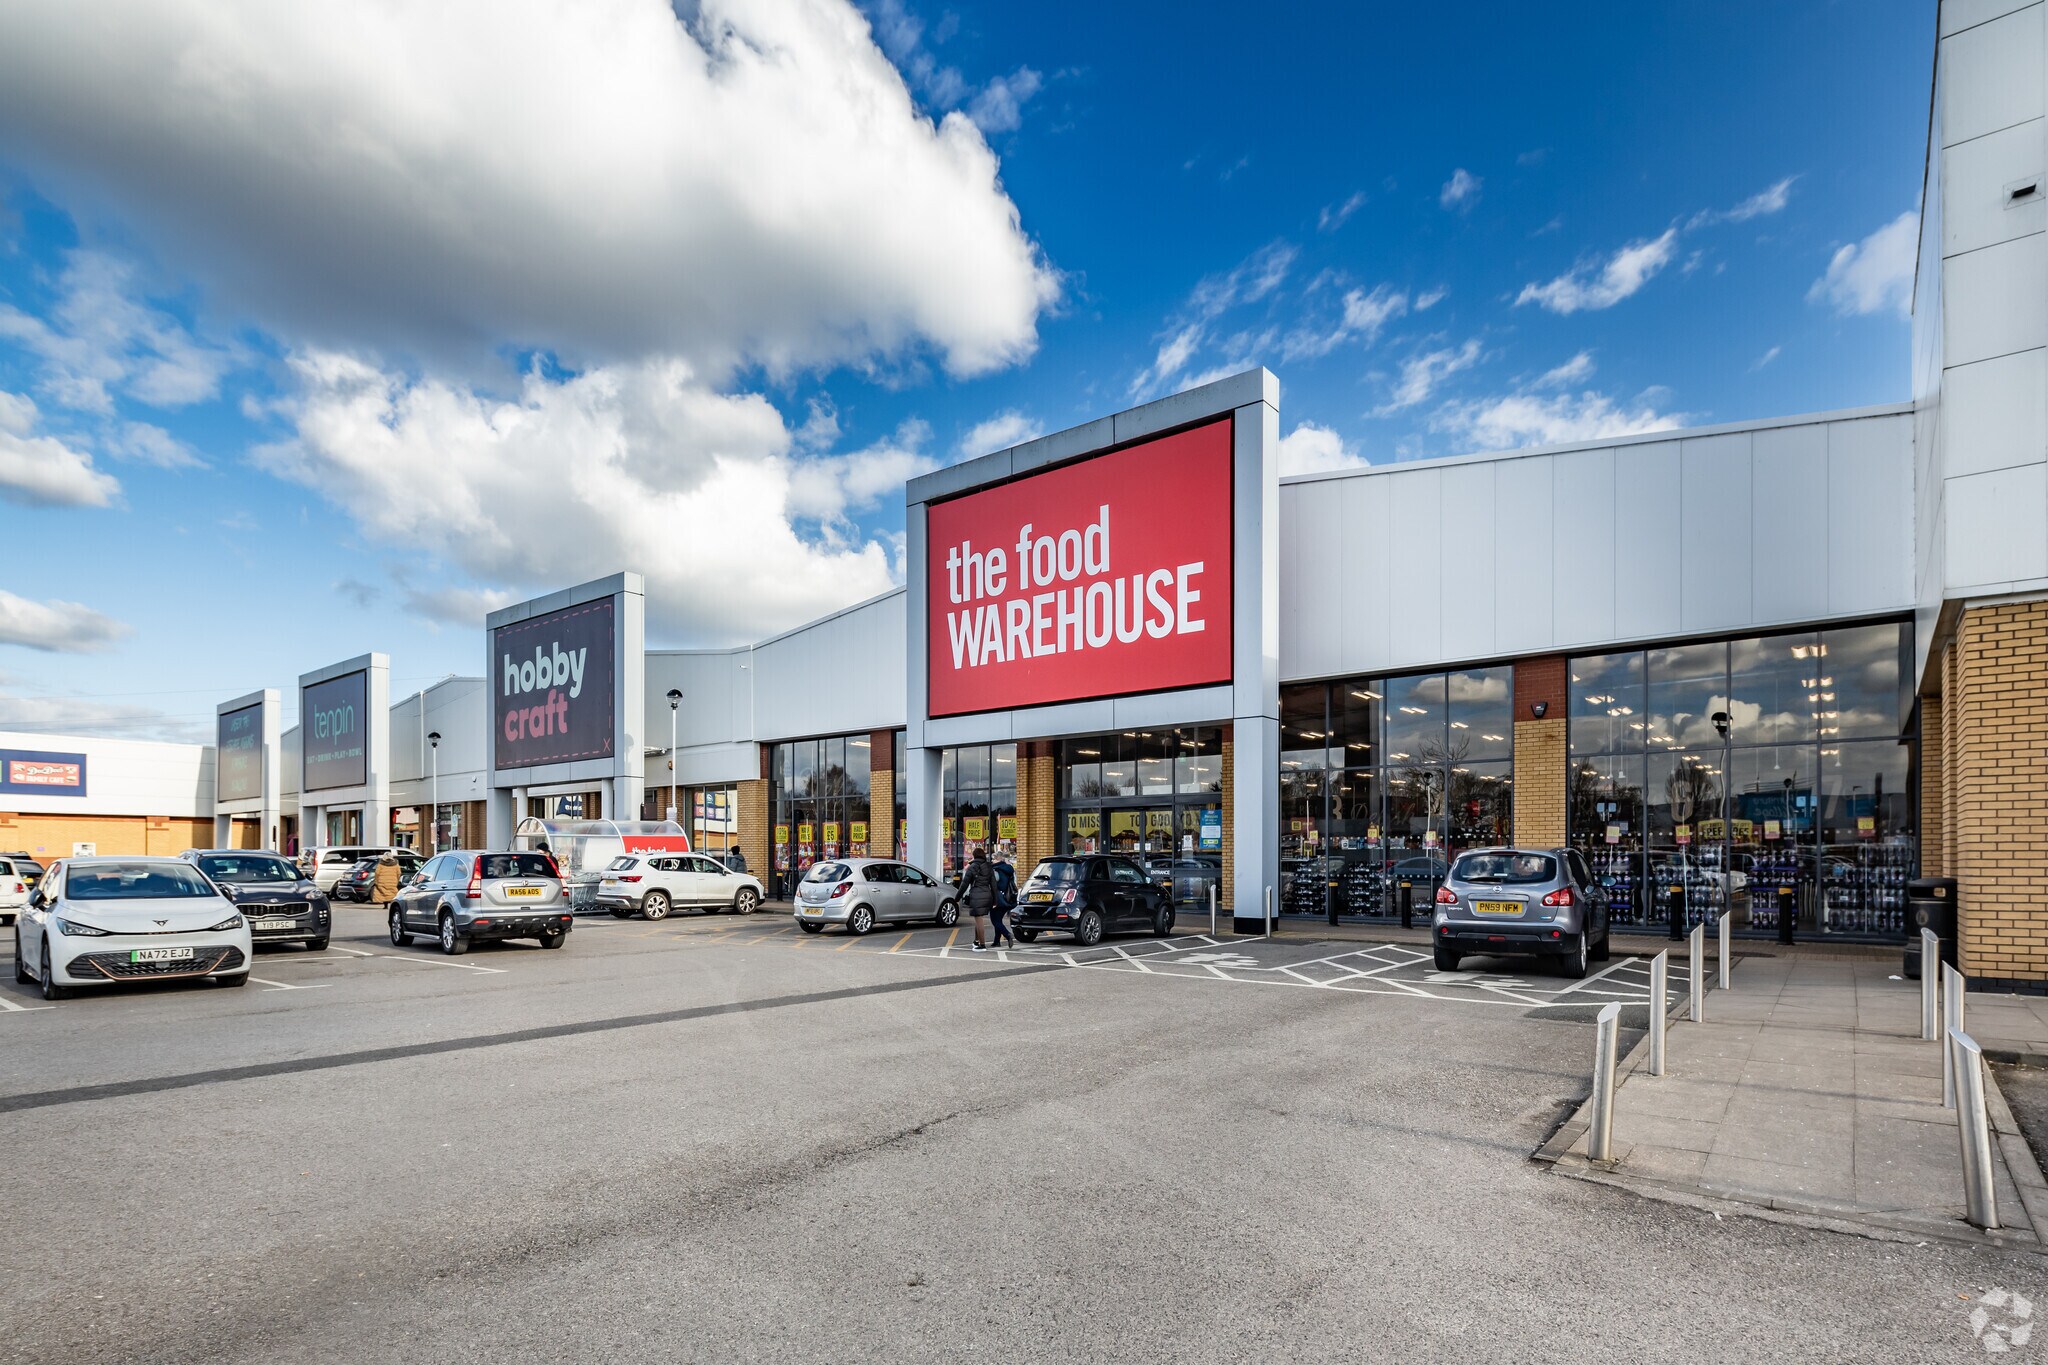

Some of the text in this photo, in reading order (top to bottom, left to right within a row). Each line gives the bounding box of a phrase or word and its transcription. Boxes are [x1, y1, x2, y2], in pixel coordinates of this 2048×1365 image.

[946, 503, 1110, 604] the food
[947, 561, 1205, 670] WAREHOUSE
[504, 641, 587, 698] hobby
[504, 688, 568, 742] craft
[314, 699, 354, 746] tenpin
[968, 821, 980, 829] HALF
[1001, 819, 1016, 829] 10%
[1150, 813, 1173, 827] GOO
[826, 830, 835, 841] £5
[968, 829, 981, 837] PRICE
[1479, 902, 1519, 912] PN59 NFM
[139, 948, 191, 960] NA72 EJZ
